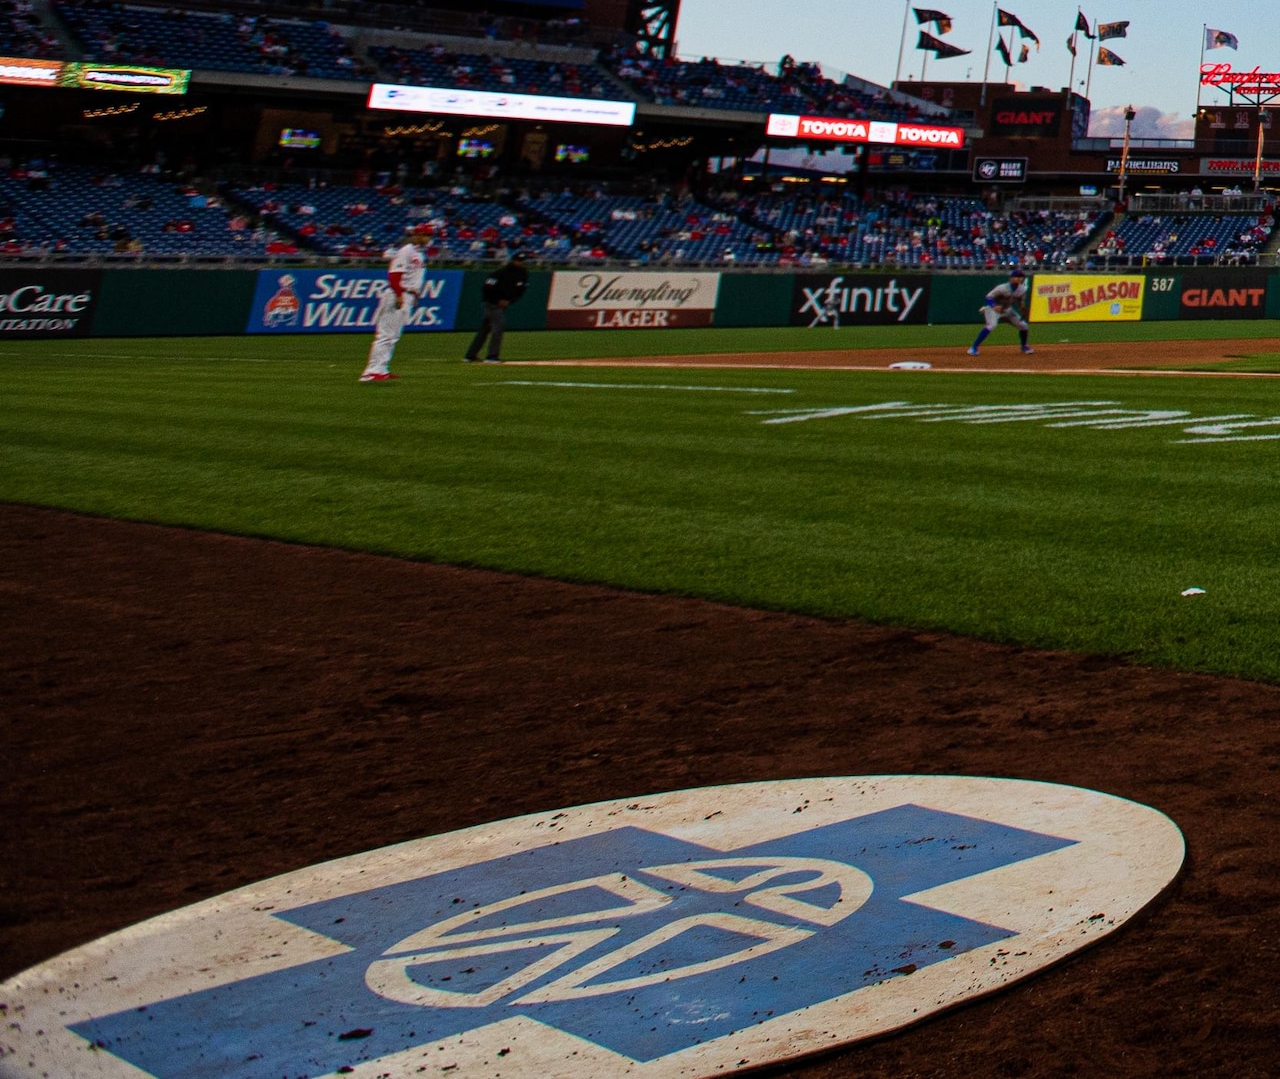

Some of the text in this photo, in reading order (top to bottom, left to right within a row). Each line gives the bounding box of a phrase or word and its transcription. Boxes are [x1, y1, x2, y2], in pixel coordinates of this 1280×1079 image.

[996, 111, 1056, 126] GIANT
[801, 120, 960, 144] TOYOTA TOYOTA
[308, 273, 446, 299] SHERN
[571, 273, 701, 309] Yuengling
[1038, 283, 1071, 295] WHO BUT
[1152, 278, 1174, 292] 387
[799, 276, 924, 322] xfinity
[1048, 281, 1141, 314] W.B.MASON
[1182, 289, 1264, 307] GIANT
[595, 310, 669, 328] LAGER
